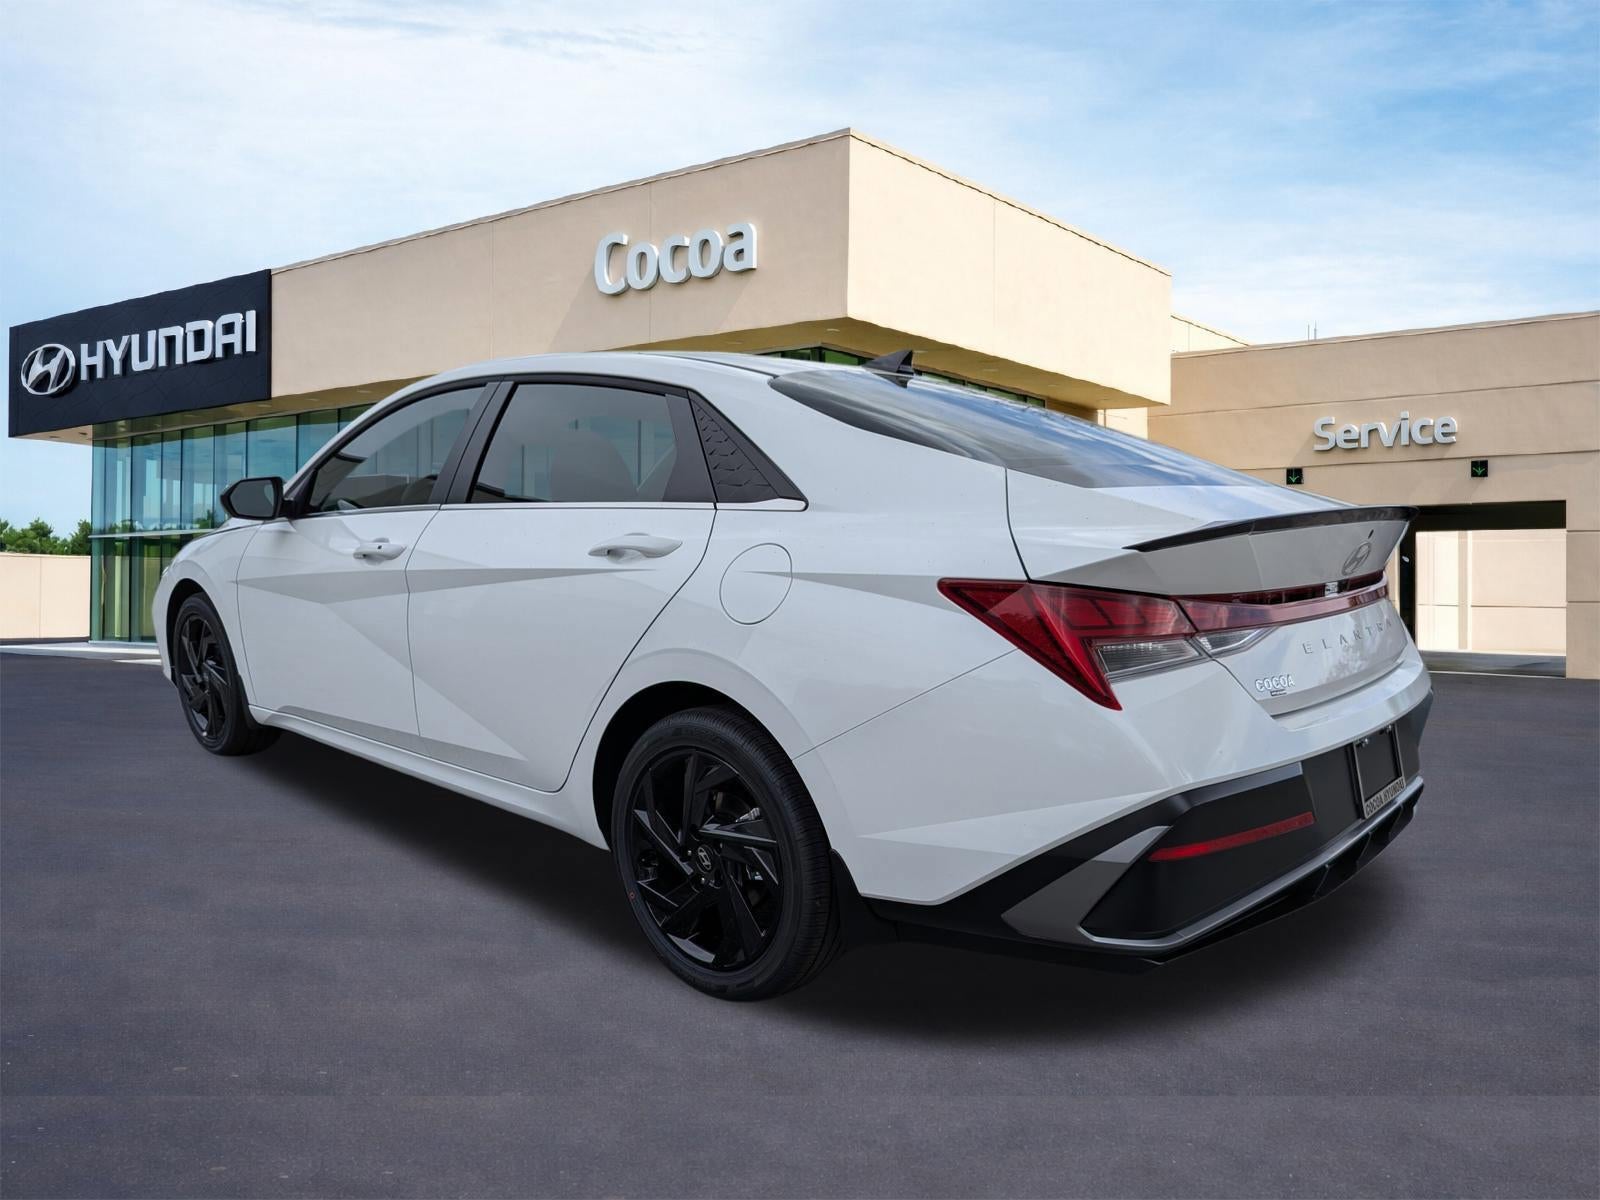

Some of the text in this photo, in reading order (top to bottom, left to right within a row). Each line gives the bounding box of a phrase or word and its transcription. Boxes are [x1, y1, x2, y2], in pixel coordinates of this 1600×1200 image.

[594, 222, 758, 296] Cocoa
[80, 309, 257, 382] HYUNDAI
[1313, 410, 1458, 451] Service
[1302, 618, 1392, 655] ELANTRA
[1255, 674, 1296, 692] COCOA
